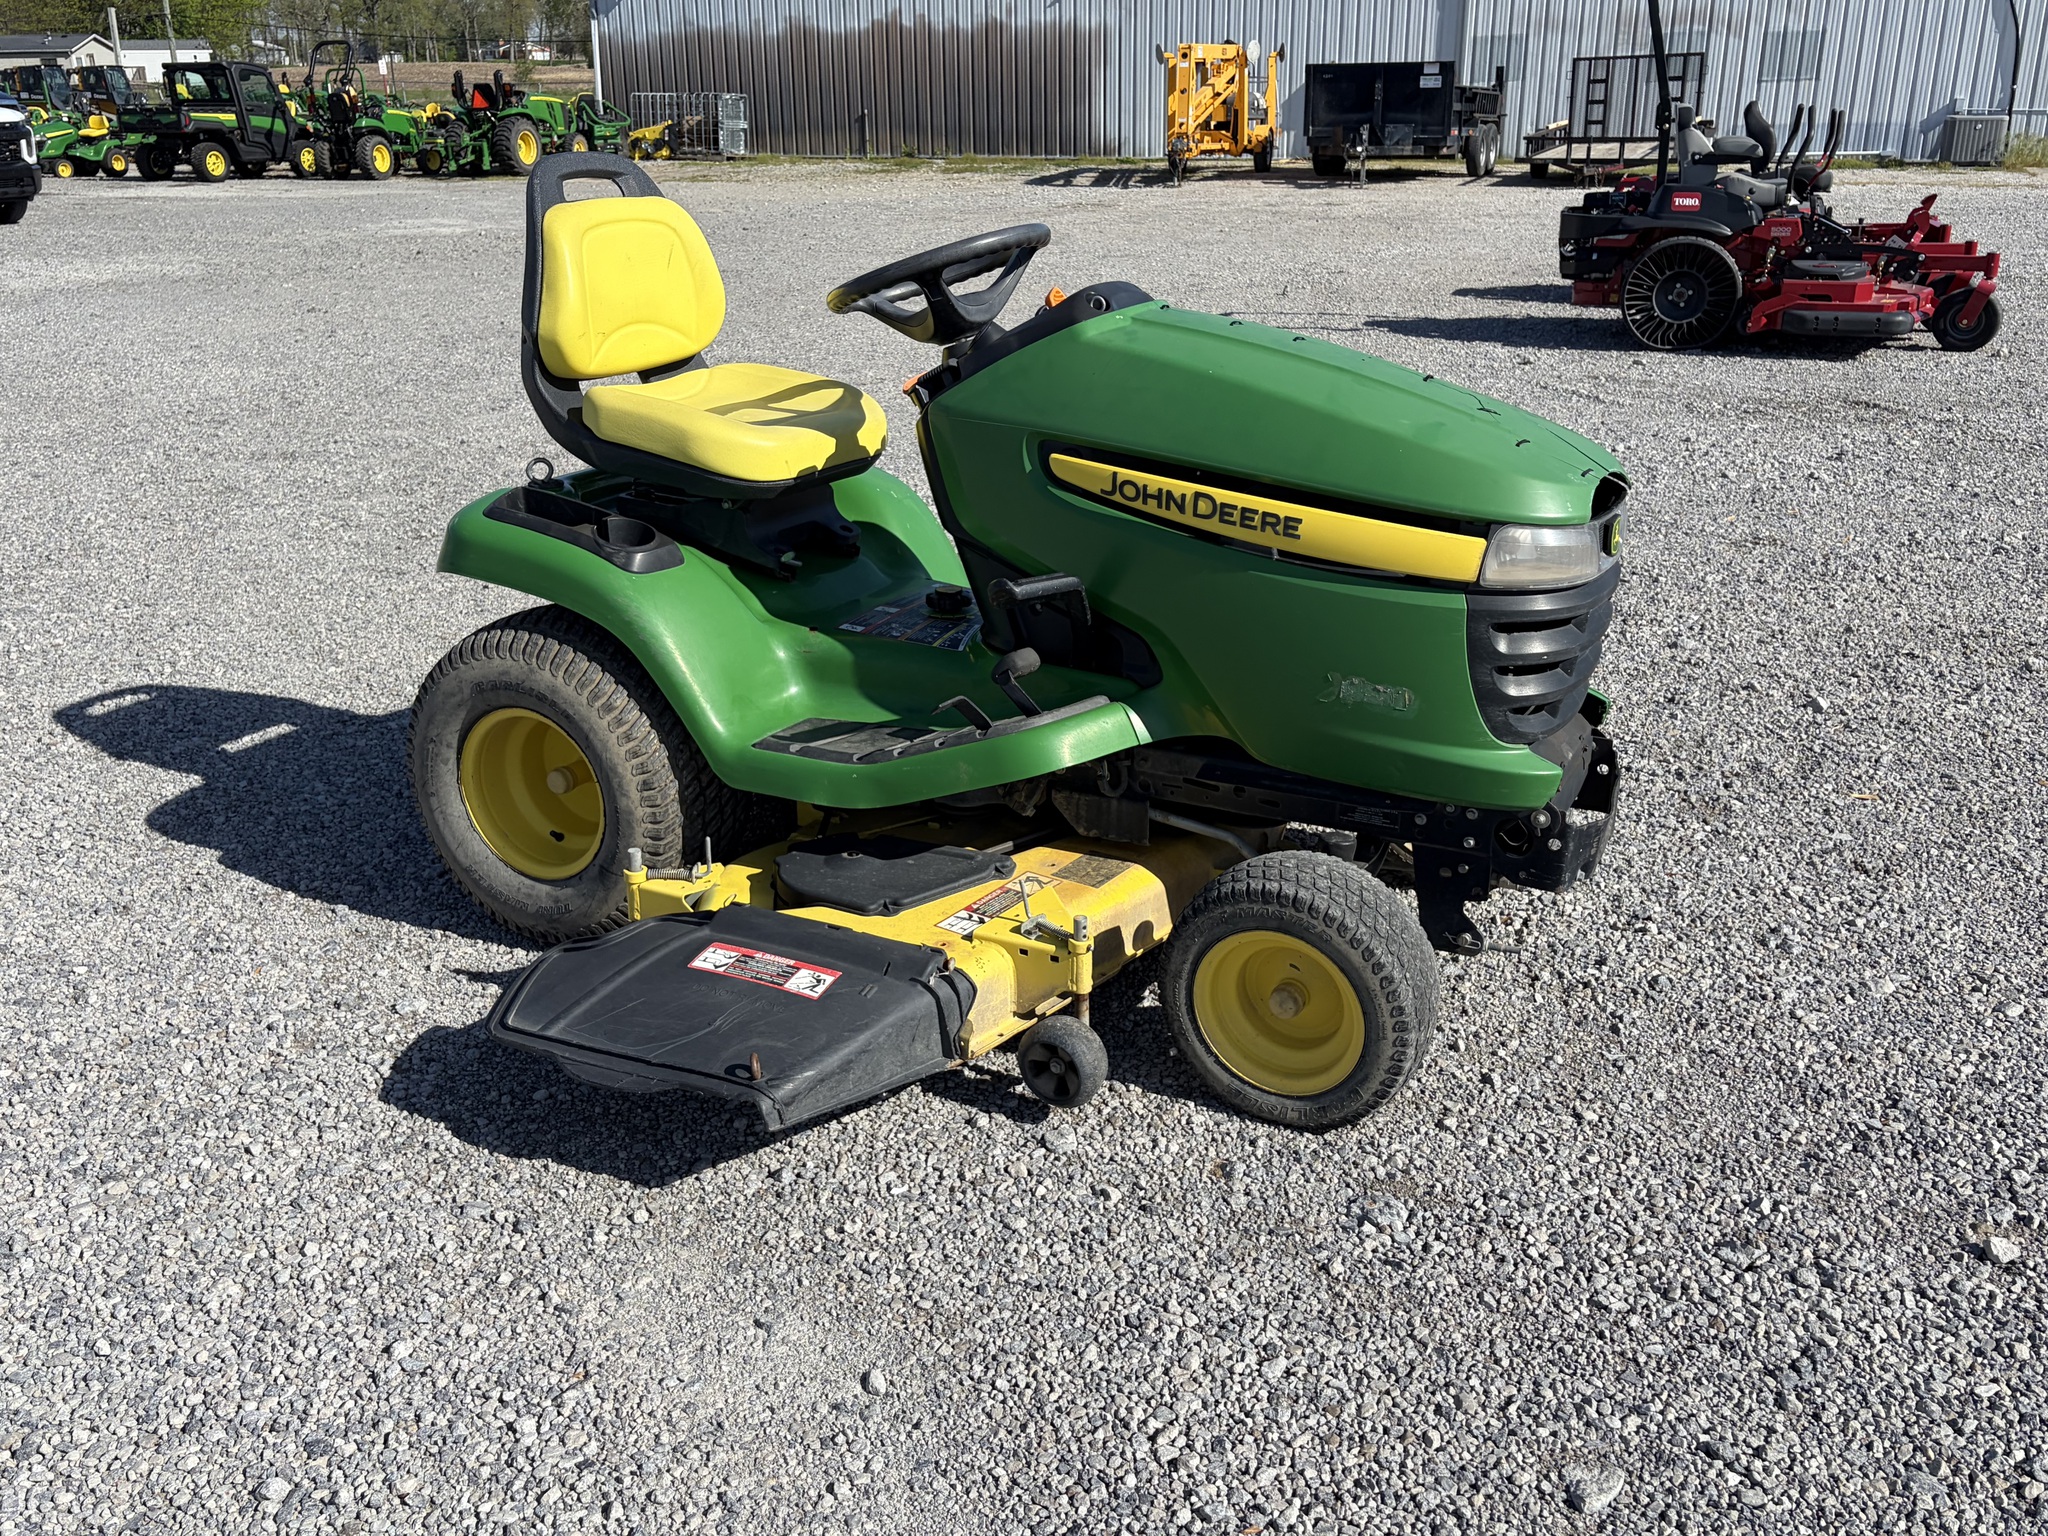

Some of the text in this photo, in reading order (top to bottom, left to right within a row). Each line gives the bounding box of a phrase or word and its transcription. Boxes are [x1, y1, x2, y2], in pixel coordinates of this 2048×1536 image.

[1674, 197, 1700, 206] TORO
[1100, 471, 1303, 540] JOHN DEERE
[1236, 906, 1333, 944] MASTER
[764, 953, 796, 965] DANGER
